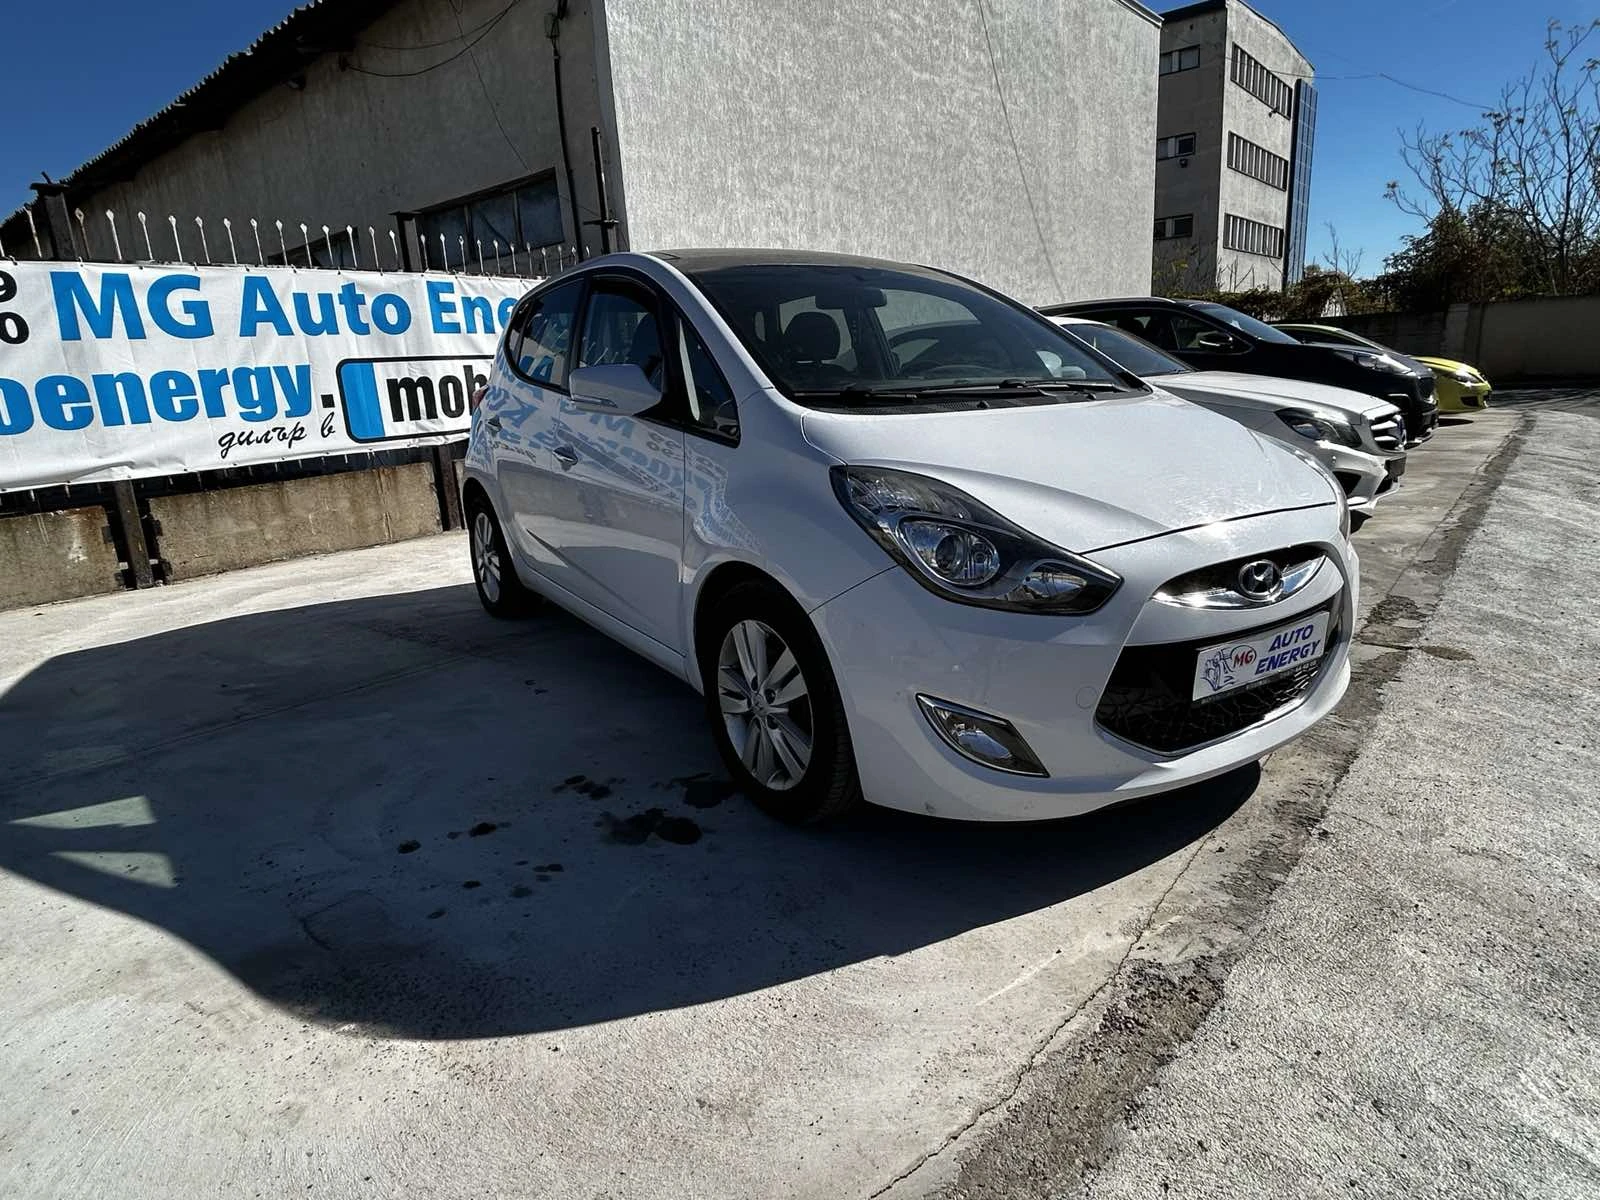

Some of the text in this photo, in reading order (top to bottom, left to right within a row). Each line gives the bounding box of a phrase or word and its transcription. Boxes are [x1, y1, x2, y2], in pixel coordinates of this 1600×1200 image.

[50, 271, 214, 342] MG
[239, 276, 412, 339] Auto
[1269, 624, 1315, 653] AUTO
[1233, 649, 1255, 669] MG
[1255, 640, 1321, 676] ENERGY
